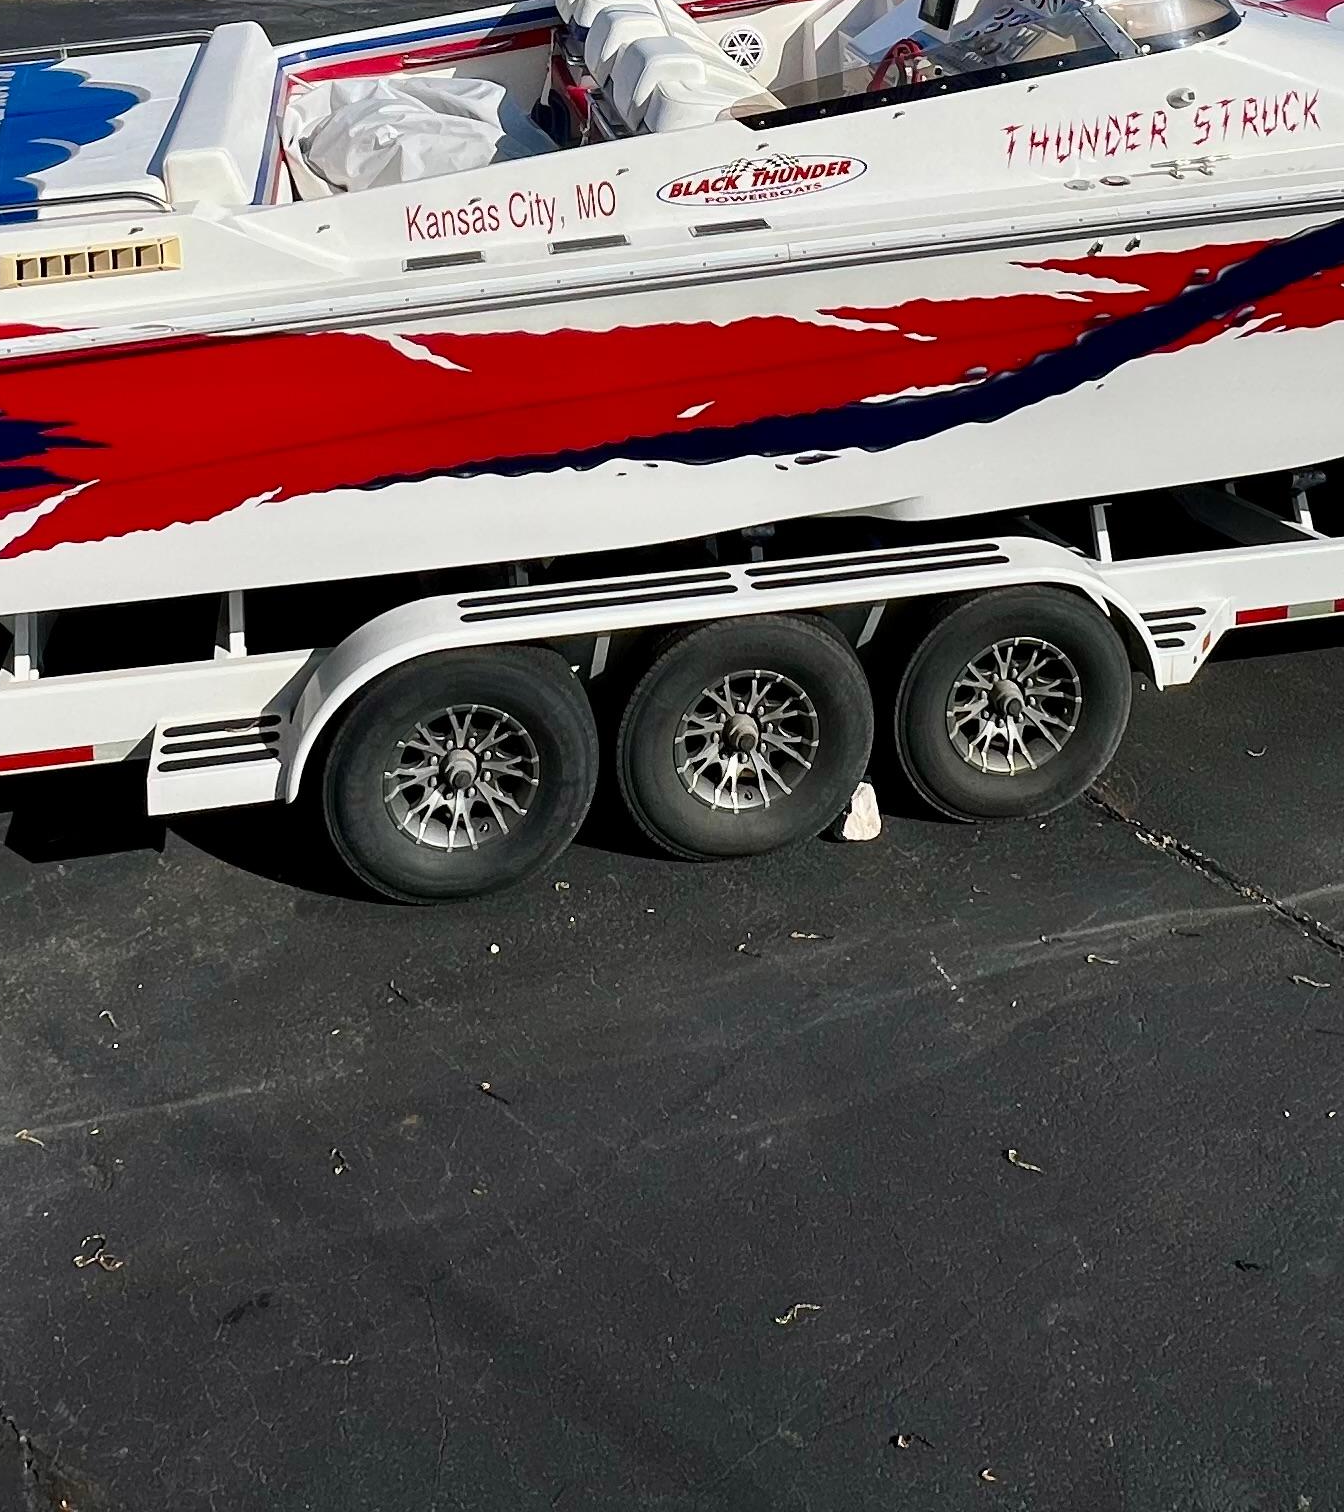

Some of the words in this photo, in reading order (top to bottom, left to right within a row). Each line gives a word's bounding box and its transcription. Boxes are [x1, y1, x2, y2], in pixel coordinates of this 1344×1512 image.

[1000, 109, 1169, 168] THUNDER
[1192, 88, 1322, 146] STRUCK
[668, 174, 742, 199] BLACK
[751, 160, 853, 188] THUNDER
[704, 182, 823, 204] POWERBOATS
[405, 203, 501, 242] Kansas
[575, 180, 617, 220] MO
